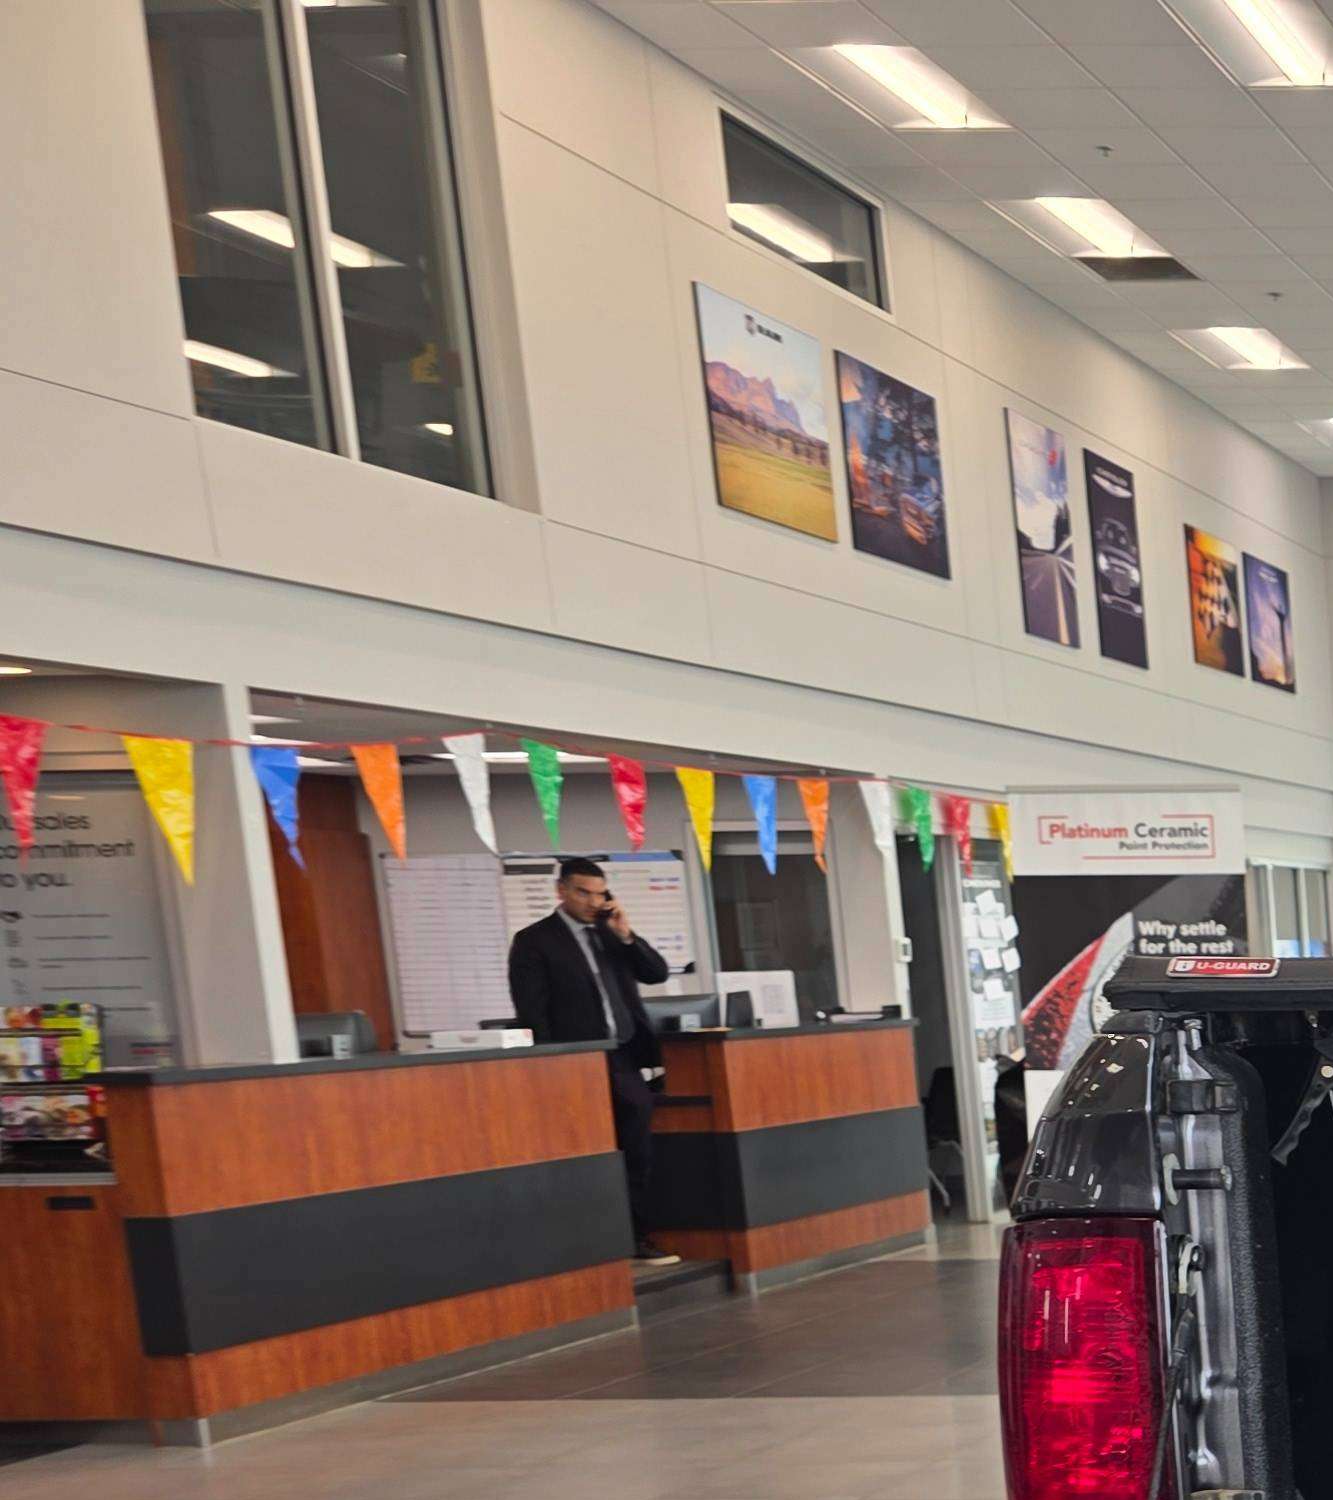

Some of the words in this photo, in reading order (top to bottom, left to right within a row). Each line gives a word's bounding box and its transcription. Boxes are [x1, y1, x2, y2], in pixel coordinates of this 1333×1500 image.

[1049, 823, 1128, 838] Platinum
[1134, 822, 1208, 838] Ceramic
[1151, 841, 1209, 851] Protection
[1138, 920, 1176, 939] Why
[1180, 920, 1227, 936] settle
[1139, 939, 1165, 954] for
[1168, 940, 1198, 954] the
[1201, 940, 1234, 954] rest
[1197, 962, 1271, 971] U-GUARD
